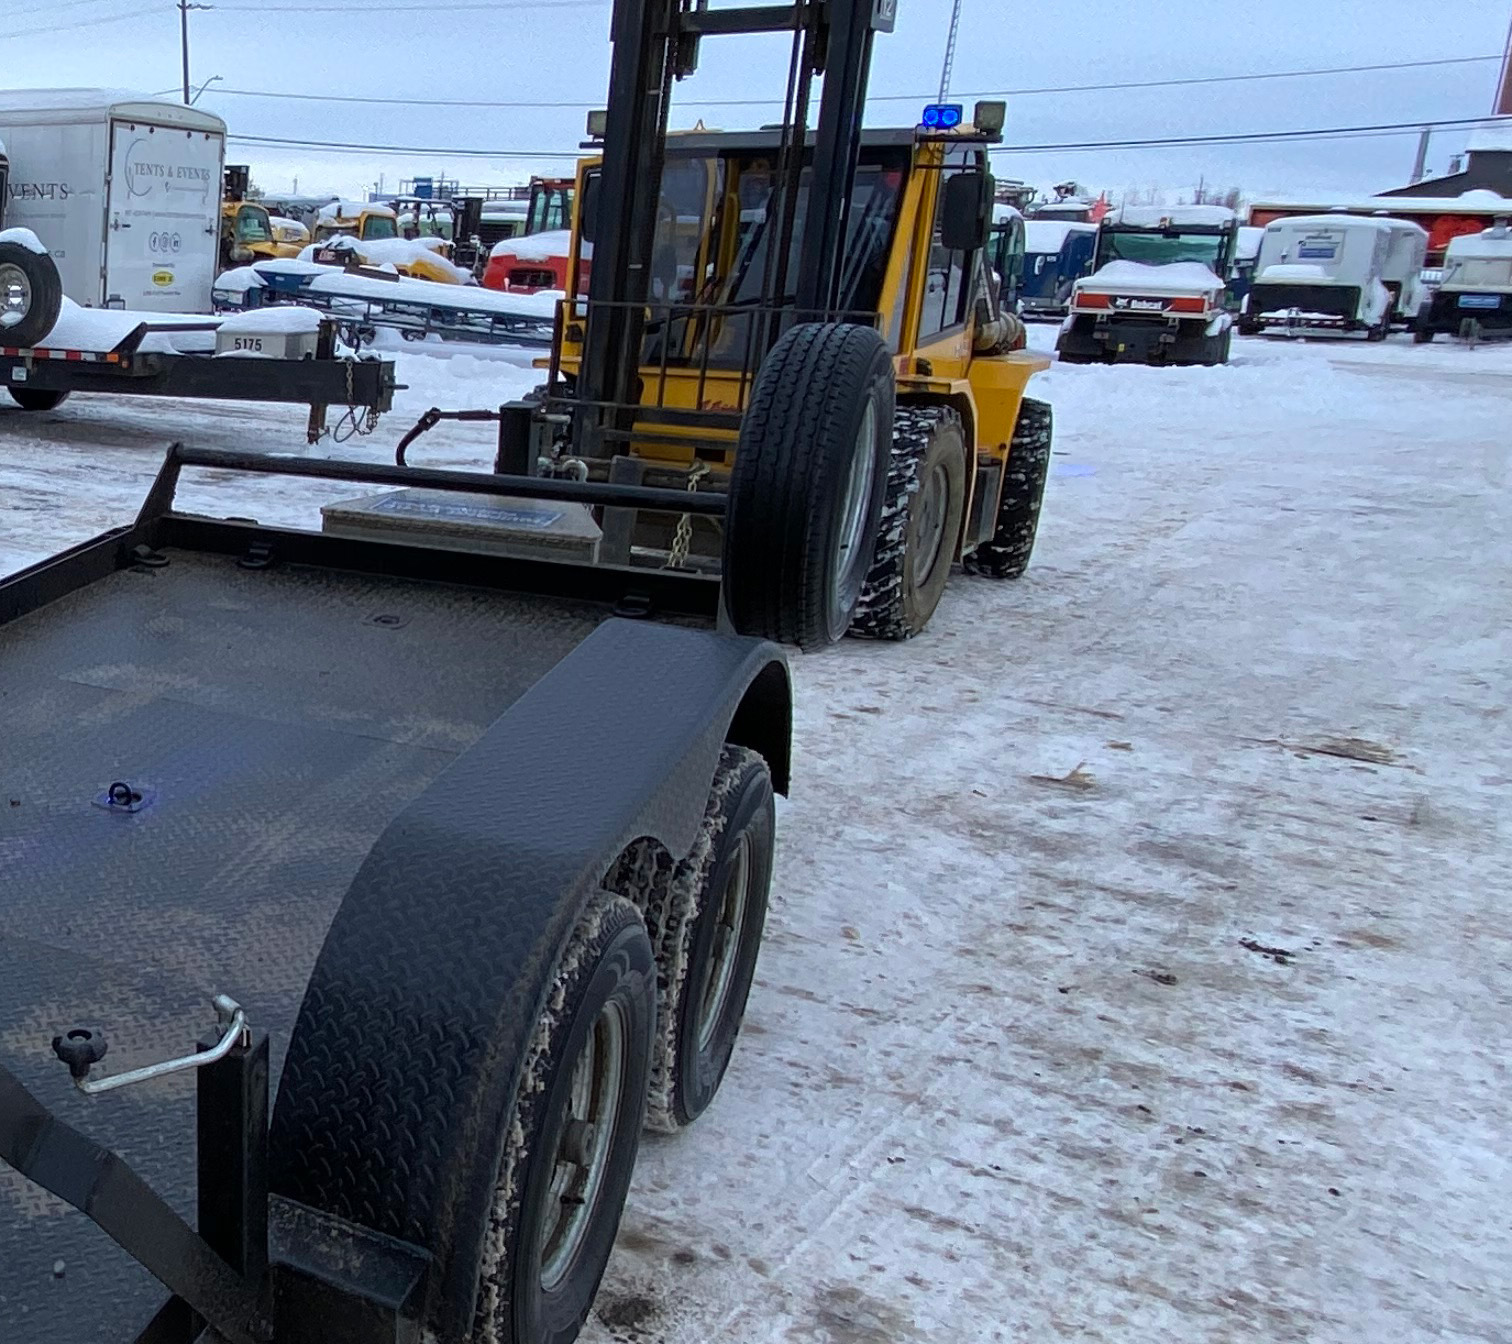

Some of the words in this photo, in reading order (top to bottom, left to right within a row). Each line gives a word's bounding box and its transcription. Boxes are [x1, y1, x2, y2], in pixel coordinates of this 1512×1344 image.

[134, 163, 165, 177] TENTS
[168, 166, 174, 177] &
[176, 166, 211, 181] EVENTS
[7, 183, 68, 200] VENTS
[234, 338, 263, 351] 5175
